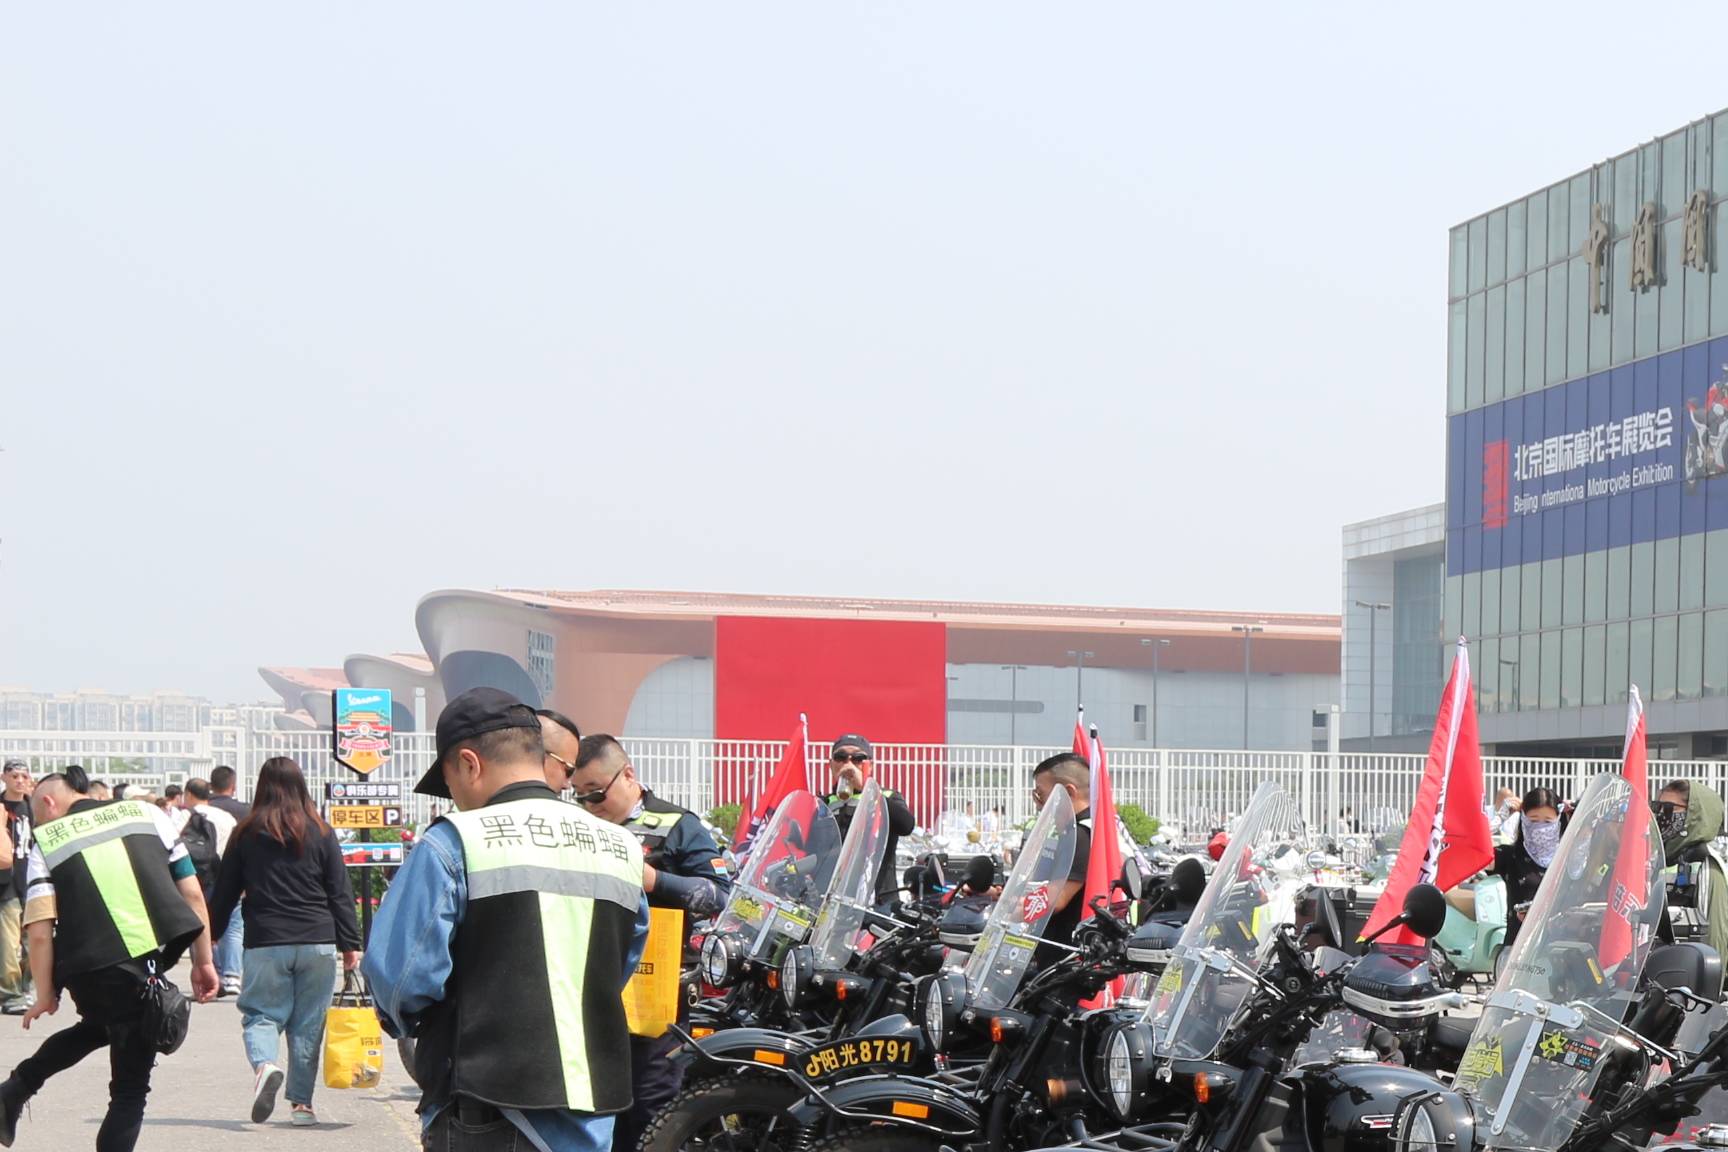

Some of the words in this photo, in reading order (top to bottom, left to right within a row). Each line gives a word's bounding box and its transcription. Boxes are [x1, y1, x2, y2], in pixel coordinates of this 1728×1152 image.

[1514, 407, 1673, 481] 北京国际摩托车展览会
[1514, 495, 1538, 515] Beijing
[1587, 474, 1631, 497] Motorcycle
[45, 802, 144, 847] 黑色蝙蝠
[332, 809, 380, 825] 停车区
[386, 809, 399, 825] P
[480, 813, 630, 864] 黑色蝙蝠
[819, 1040, 911, 1073] 阳光8791
